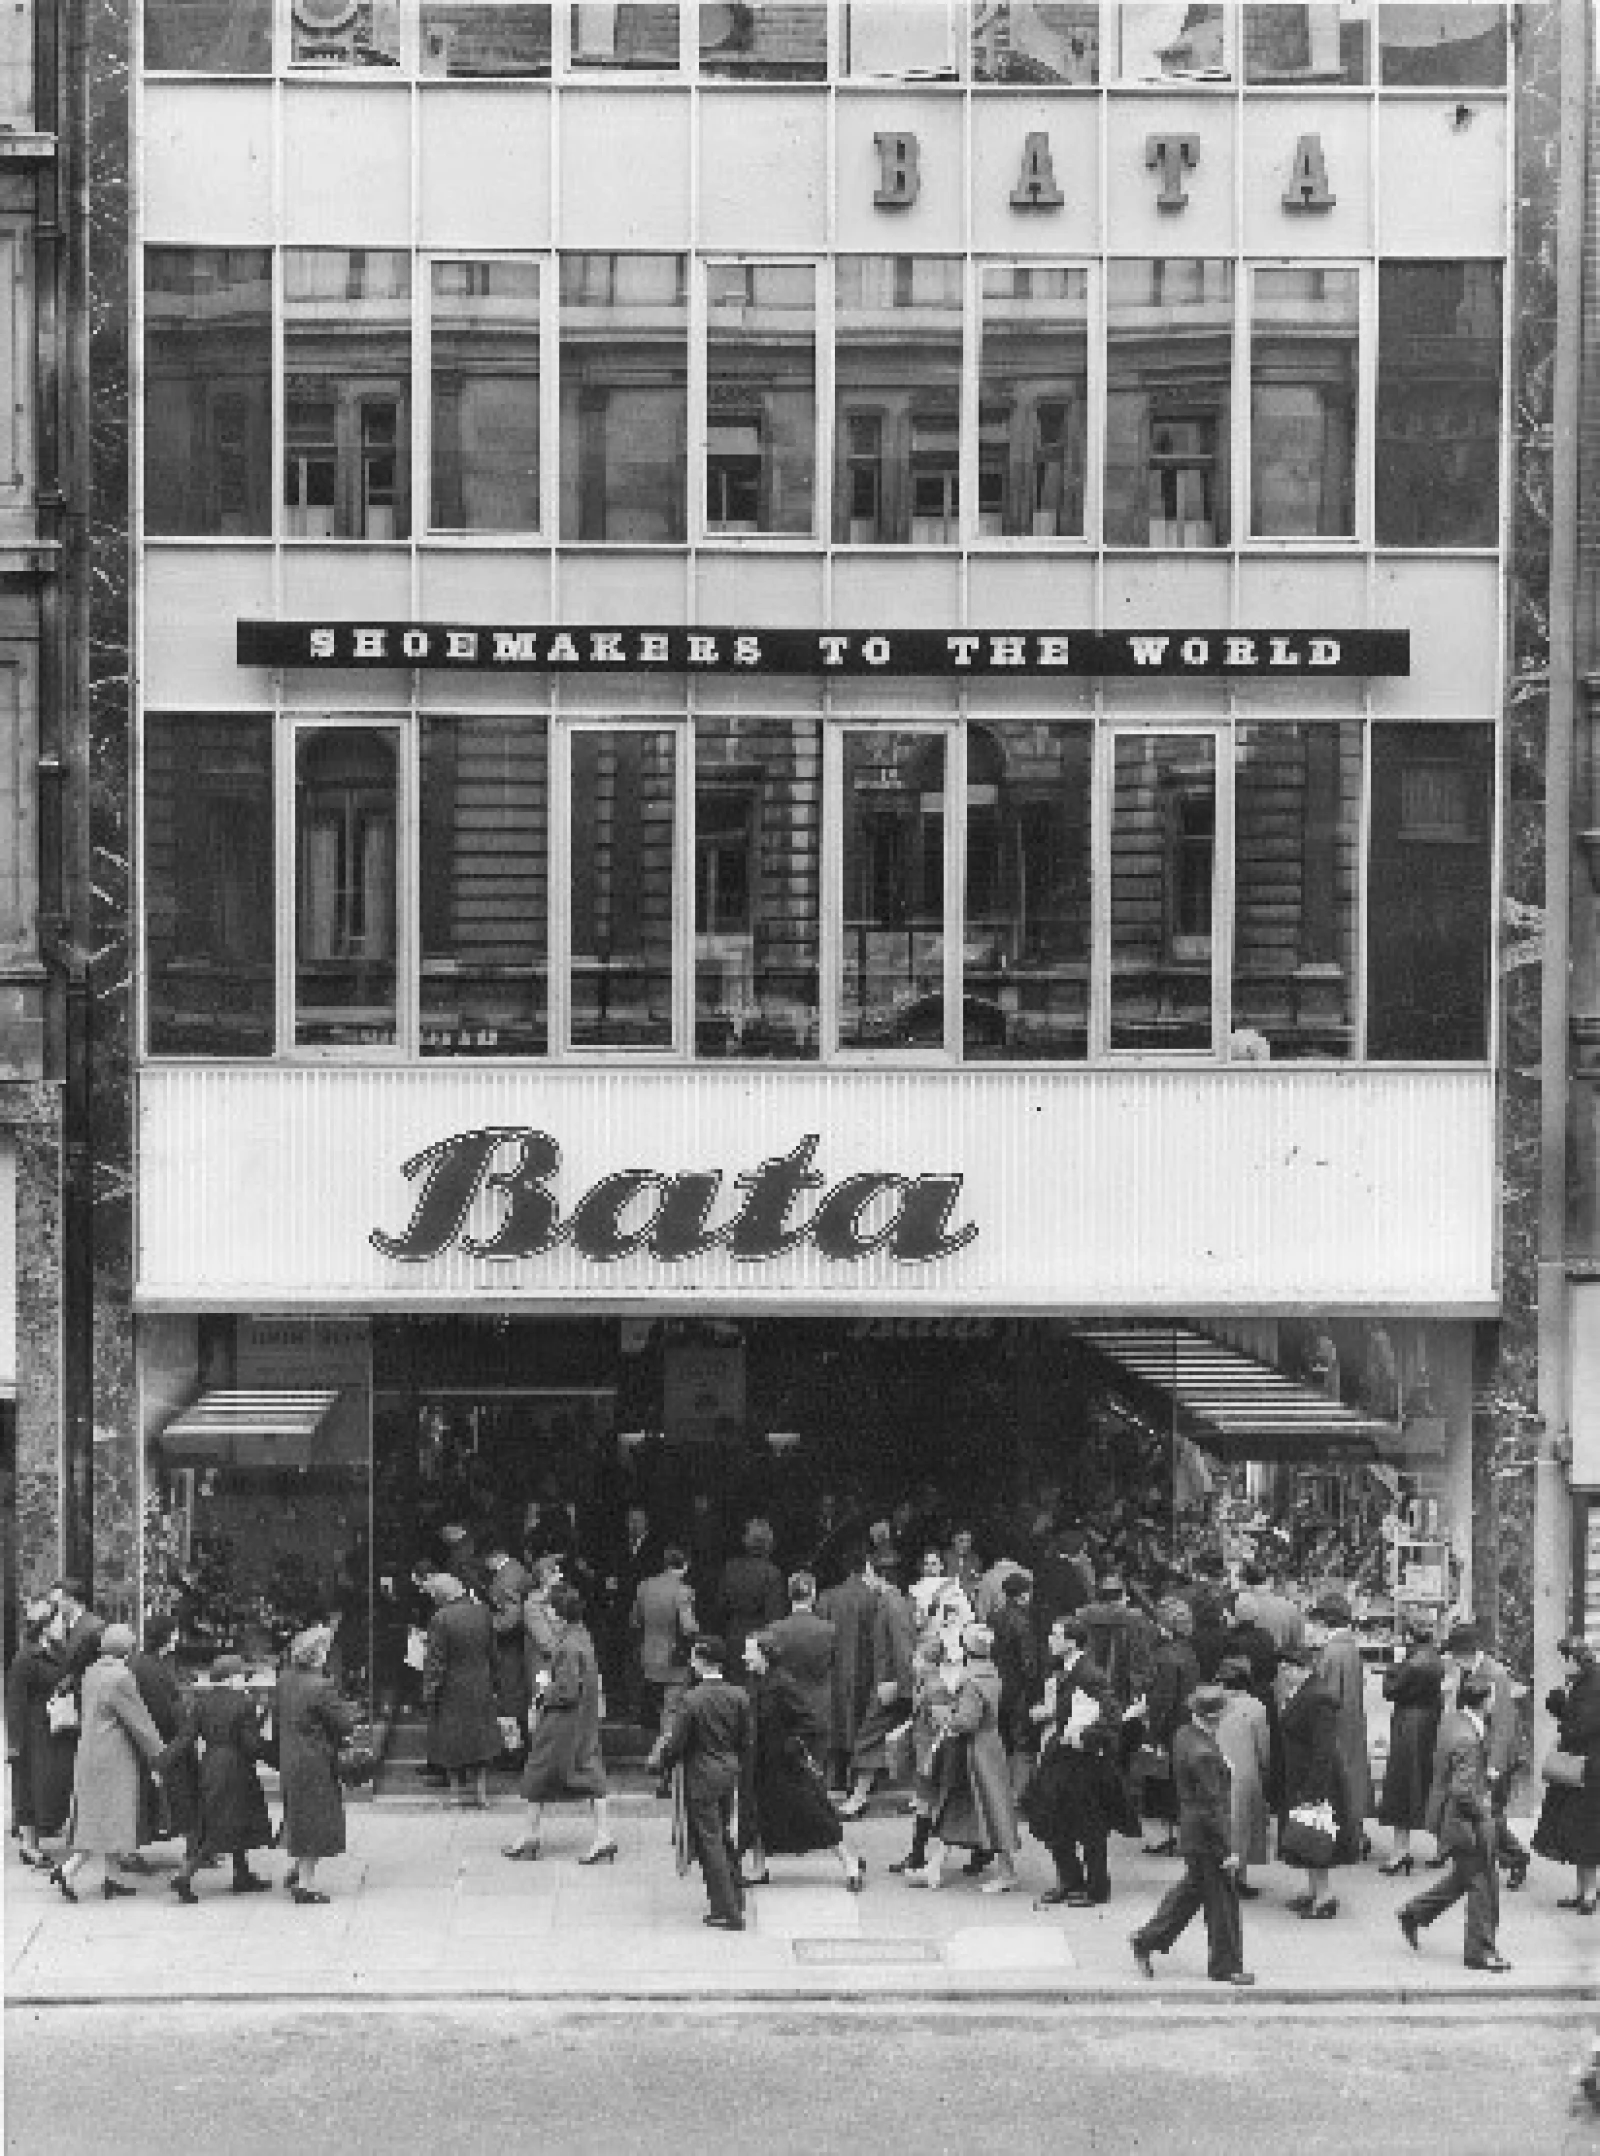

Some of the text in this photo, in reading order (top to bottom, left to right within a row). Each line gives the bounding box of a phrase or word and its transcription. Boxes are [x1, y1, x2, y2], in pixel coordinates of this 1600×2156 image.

[873, 132, 1337, 210] BATA
[310, 629, 1342, 665] SHOEMAKERS TO THE WORLD
[369, 1126, 979, 1266] Bata
